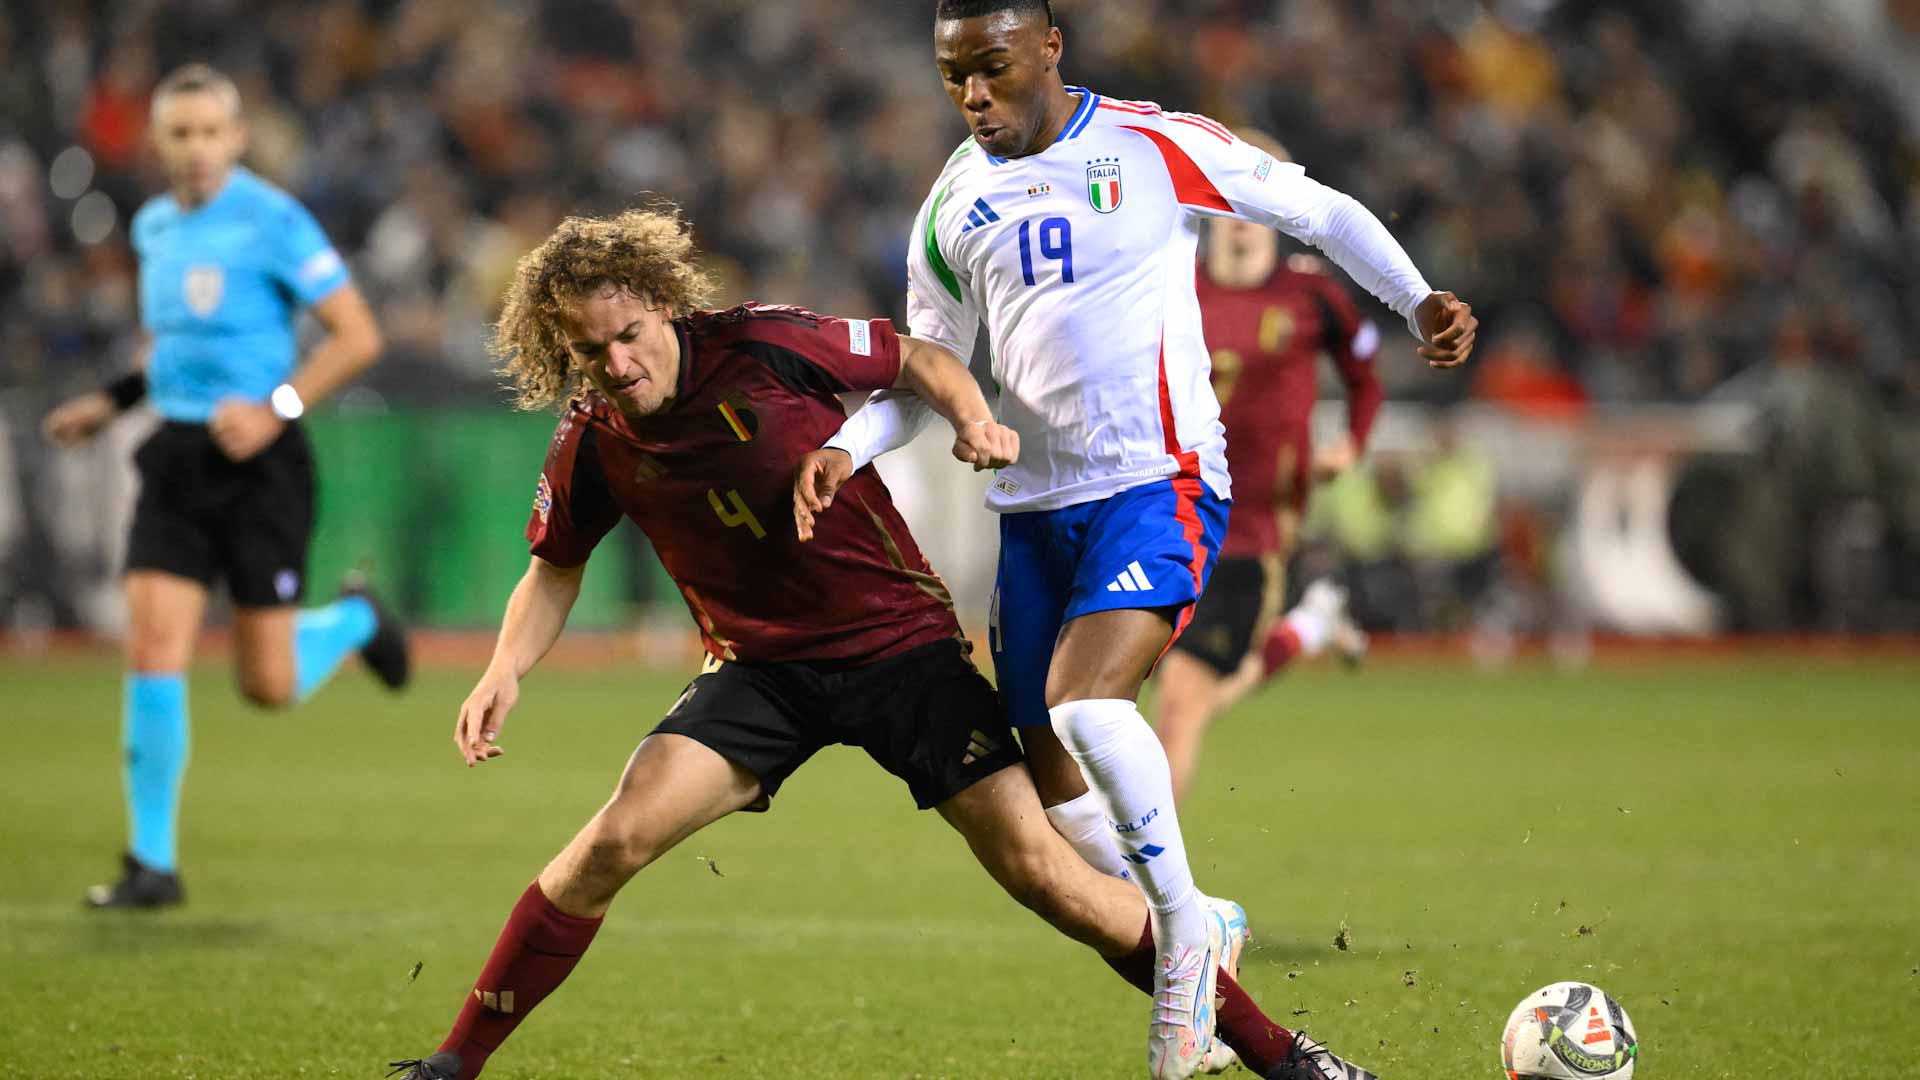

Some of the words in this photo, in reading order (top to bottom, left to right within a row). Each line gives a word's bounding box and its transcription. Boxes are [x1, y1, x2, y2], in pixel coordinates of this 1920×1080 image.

[1089, 167, 1118, 179] ITALIA
[1018, 216, 1074, 286] 19
[706, 487, 768, 540] 4
